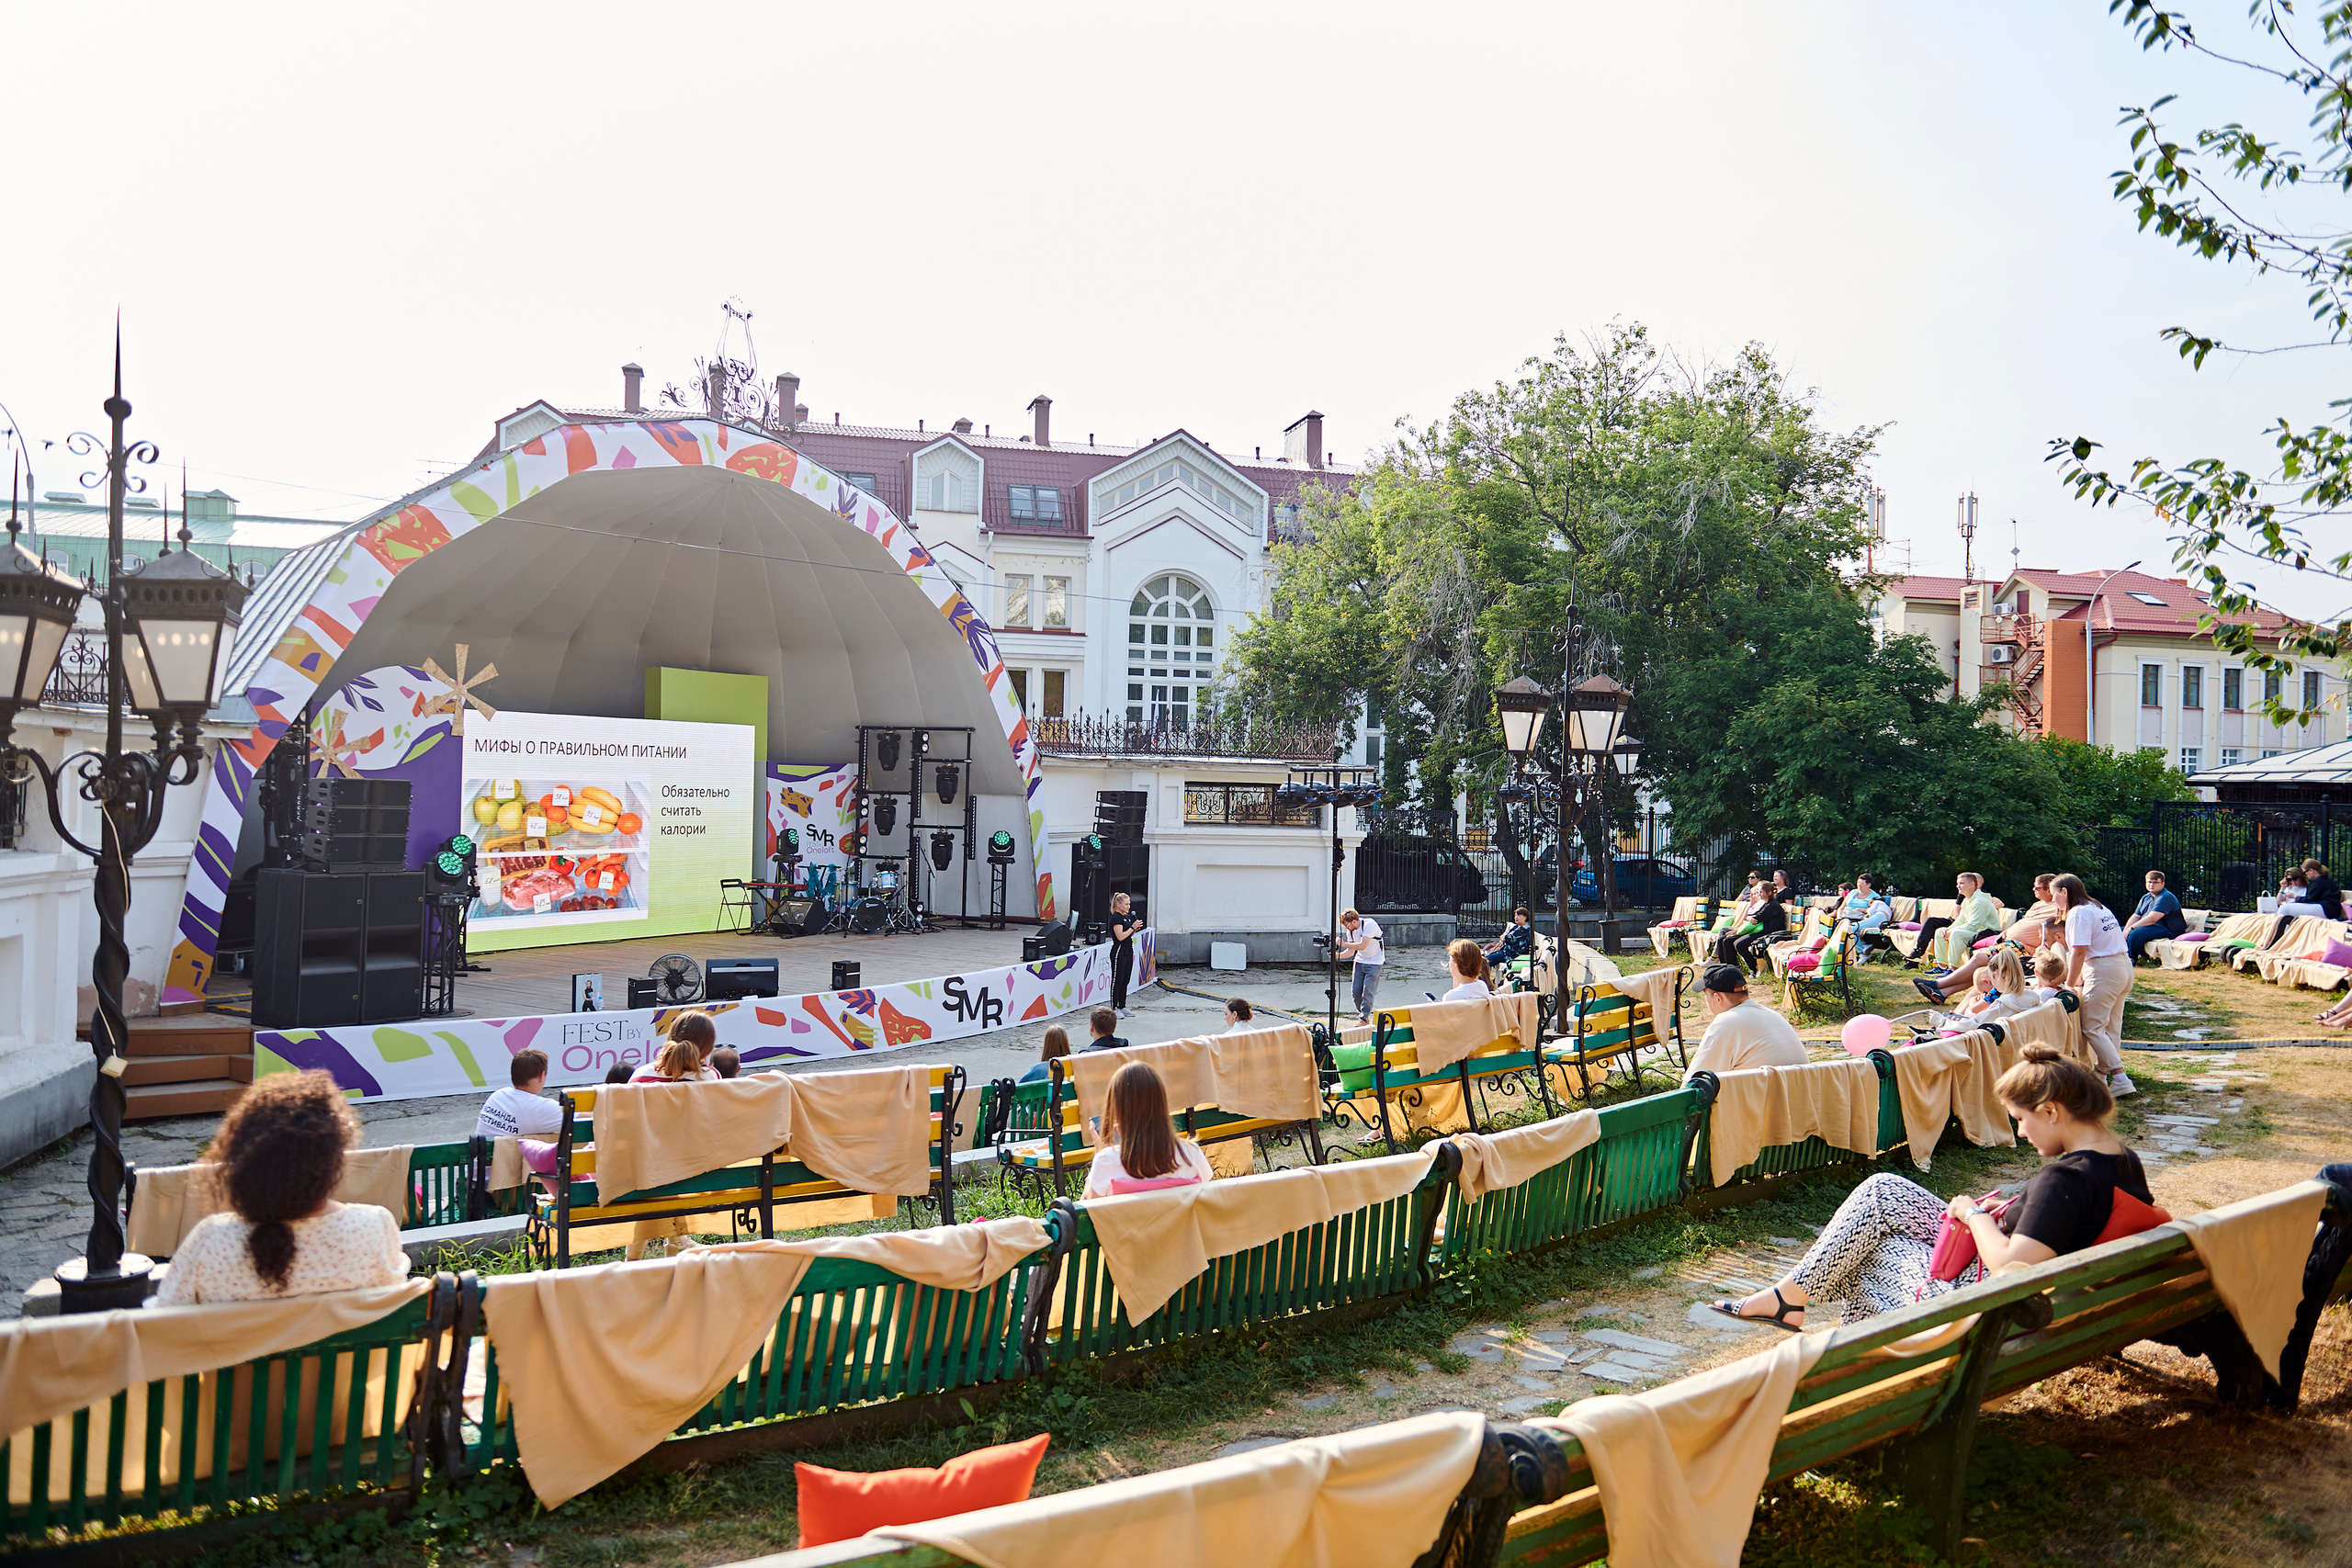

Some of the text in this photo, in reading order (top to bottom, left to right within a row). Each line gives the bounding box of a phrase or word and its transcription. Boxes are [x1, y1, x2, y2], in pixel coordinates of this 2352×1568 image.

[475, 738, 686, 759] МИФЫ О ПРАВИЛЬНОМ ПИТАНИИ
[662, 784, 730, 798] Обязательно
[661, 807, 702, 817] считать
[661, 825, 707, 838] калории
[806, 824, 834, 846] SMR
[942, 976, 1003, 1030] SMR
[562, 1020, 644, 1045] FEST BY
[480, 1113, 519, 1134] ЕСТИВАЛЯ
